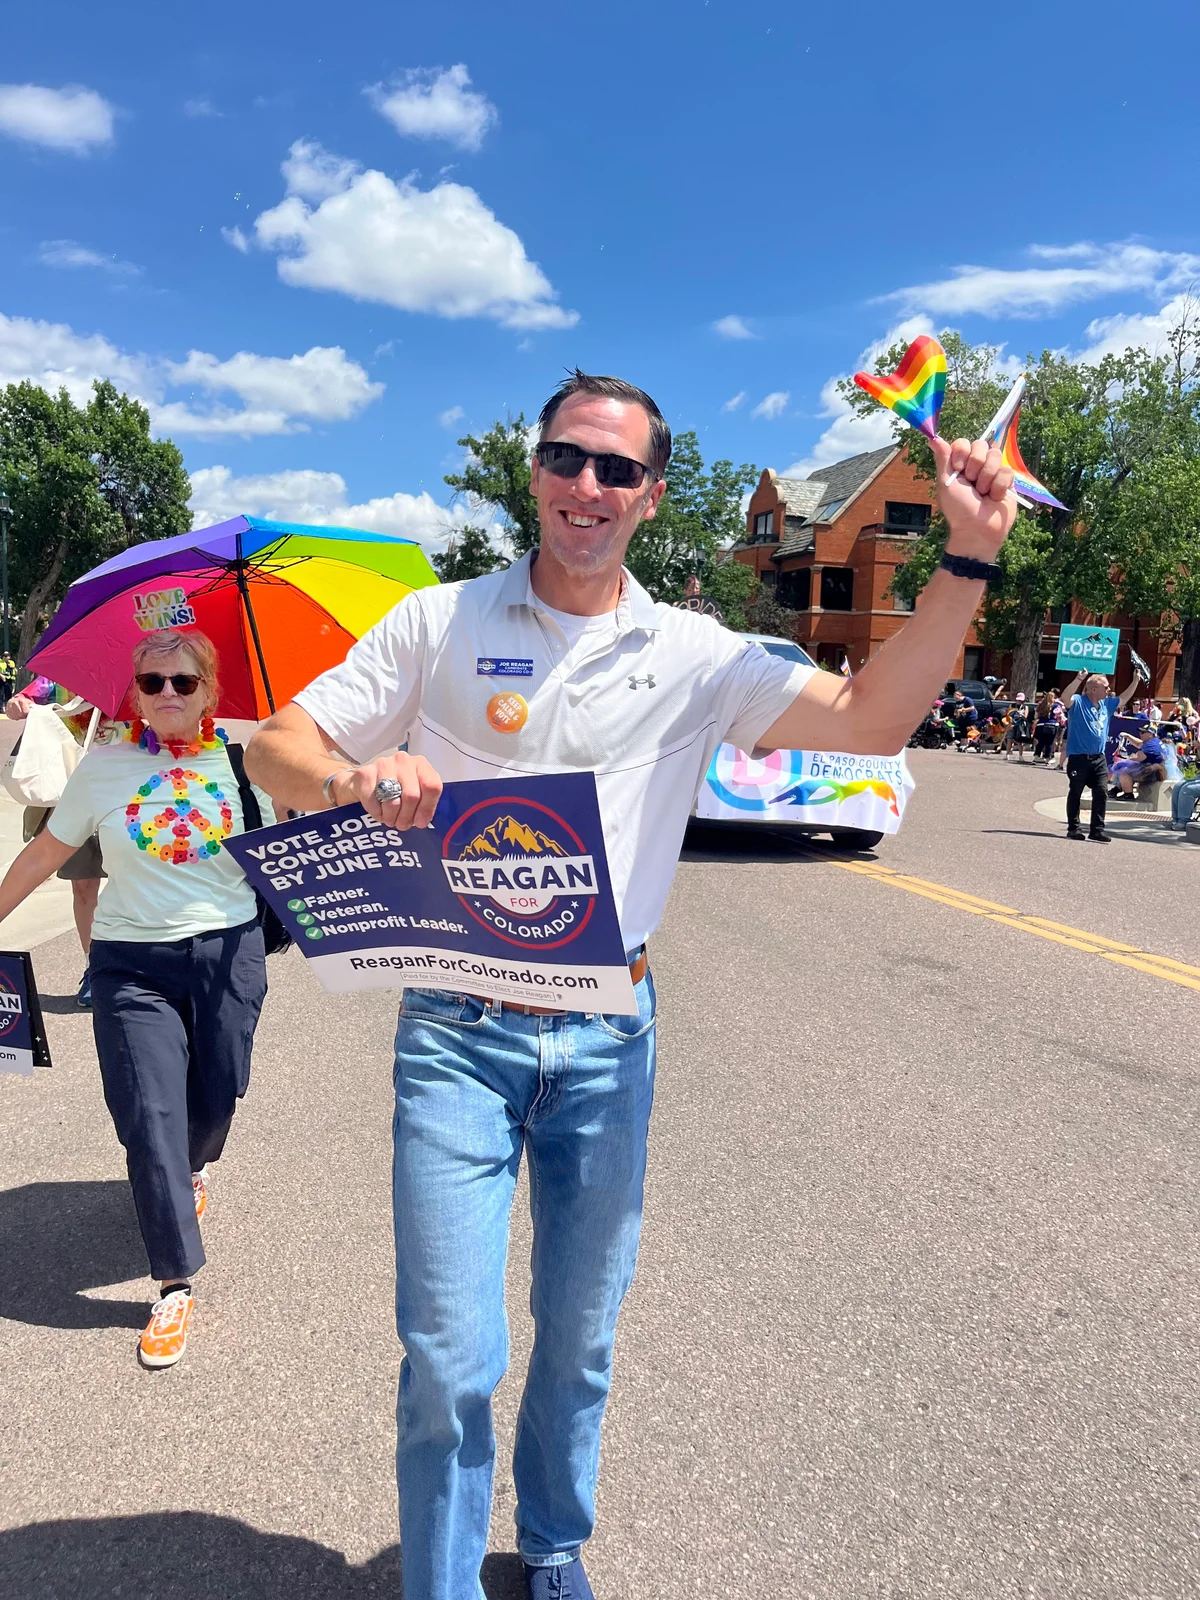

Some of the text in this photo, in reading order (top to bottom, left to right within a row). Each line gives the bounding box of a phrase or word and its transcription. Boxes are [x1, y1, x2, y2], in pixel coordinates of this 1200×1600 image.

[134, 588, 186, 610] LOVE
[134, 608, 195, 630] WINS!
[1061, 637, 1114, 659] LÓPEZ
[498, 699, 515, 717] CALM
[507, 696, 522, 710] KEEP
[495, 708, 511, 724] VOTE
[813, 753, 901, 770] EL PASO COUNTY
[810, 763, 903, 785] DEMOCRATS
[246, 813, 382, 860] VOTE JOE
[260, 830, 403, 875] CONGRESS
[270, 850, 422, 891] BY JUNE 25!
[447, 863, 593, 890] REAGAN
[304, 887, 370, 908] Father.
[510, 897, 539, 908] FOR
[312, 901, 389, 921] Veteran.
[321, 915, 468, 938] Nonprofit Leader.
[483, 909, 575, 938] COLORADO
[350, 954, 599, 989] ReaganForColorado.com
